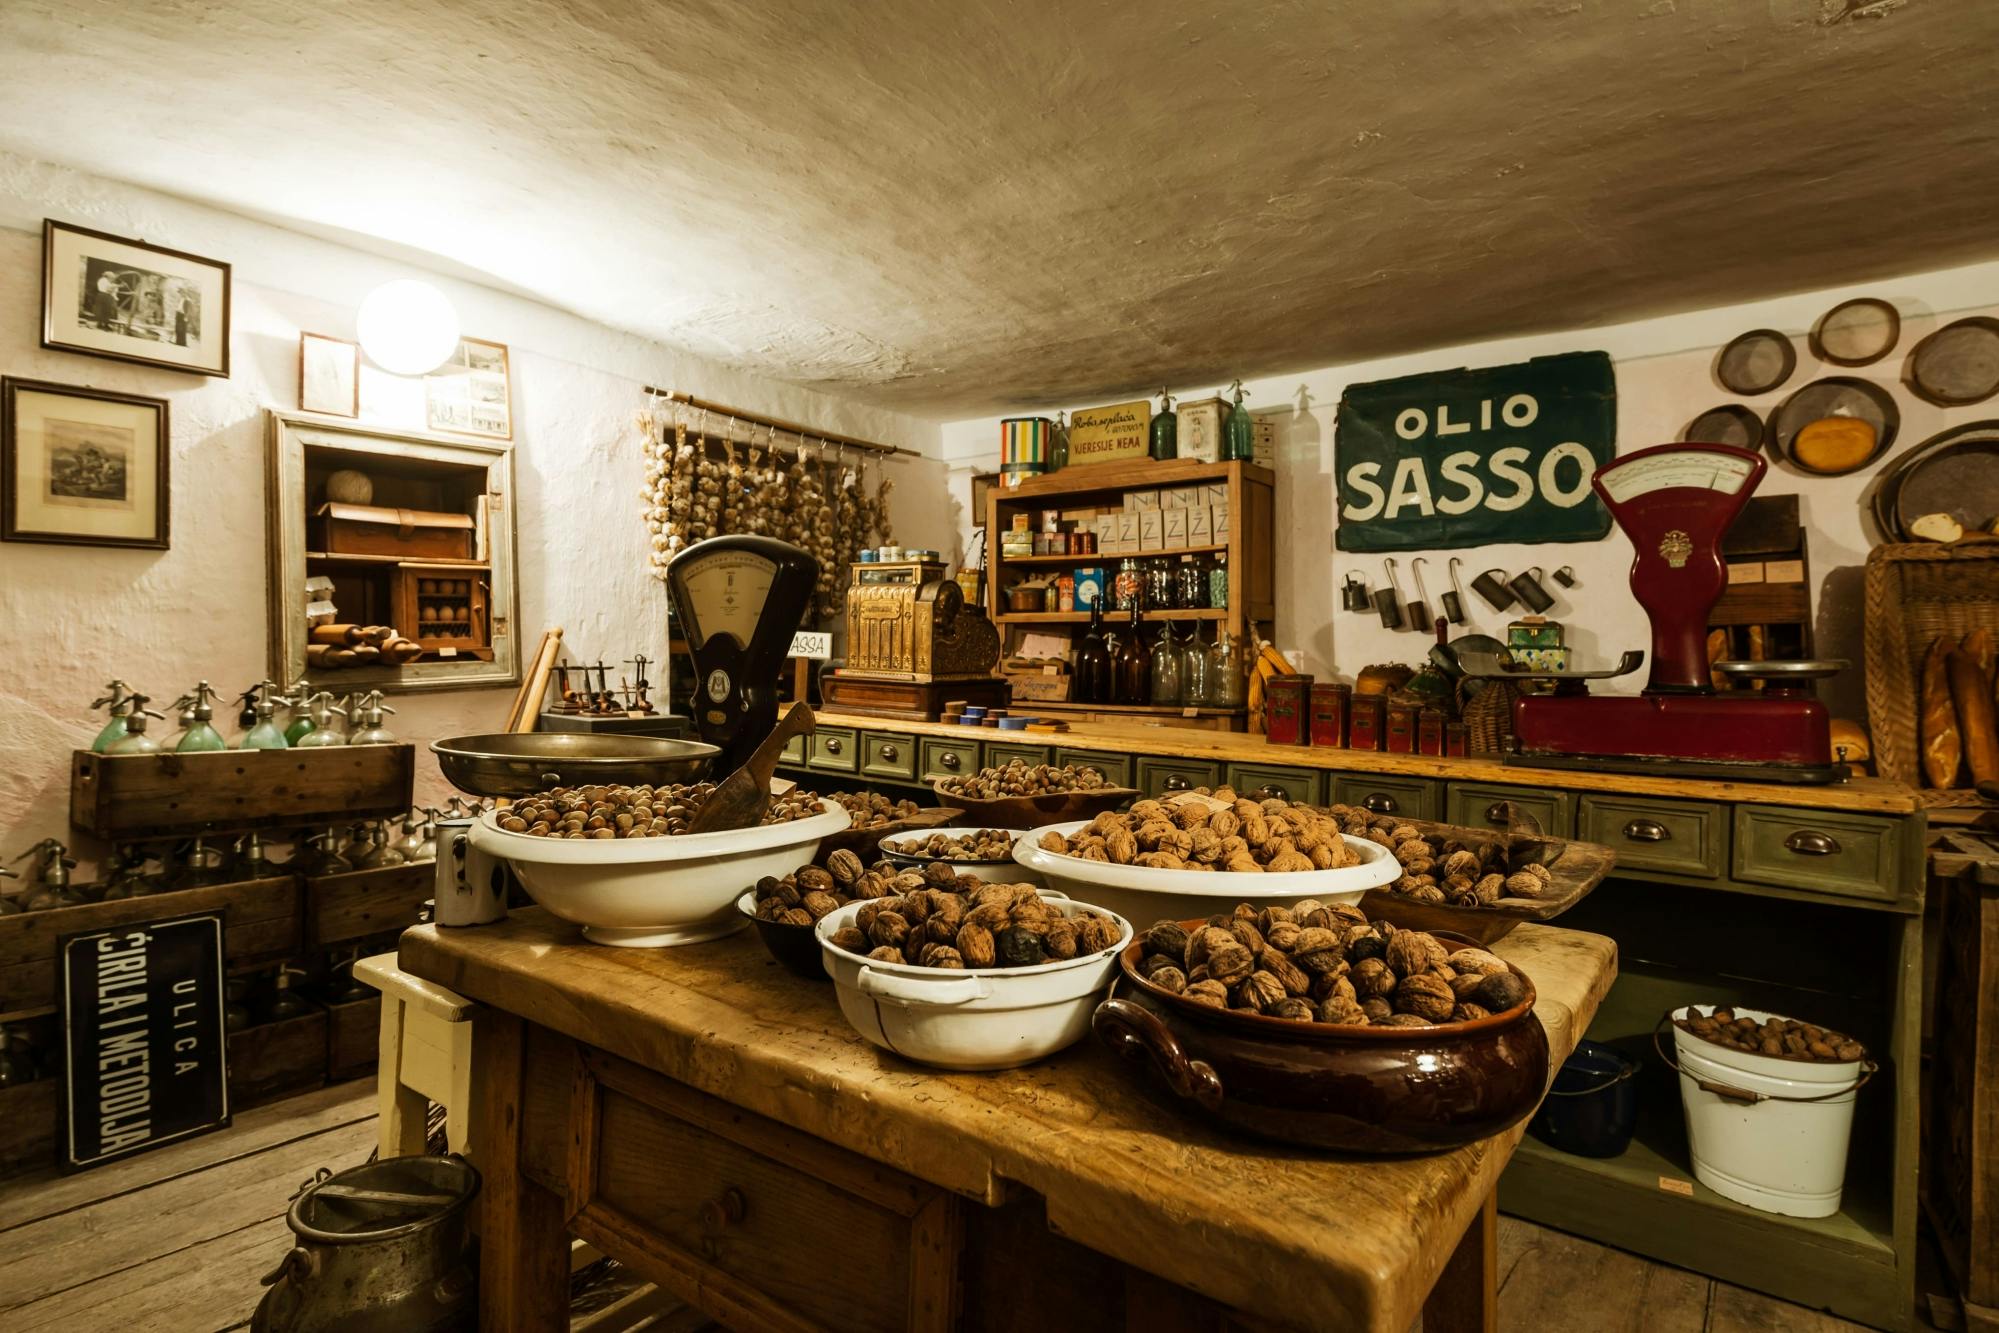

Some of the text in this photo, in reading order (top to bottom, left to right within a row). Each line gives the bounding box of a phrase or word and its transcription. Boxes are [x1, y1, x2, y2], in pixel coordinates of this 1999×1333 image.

[1116, 436, 1141, 450] NEMA
[1395, 393, 1539, 440] OLIO
[1342, 442, 1598, 522] SASSO
[790, 636, 824, 654] ASSA
[97, 932, 153, 1154] ĆIRILA I METODIJA
[172, 979, 199, 1076] ULICA
